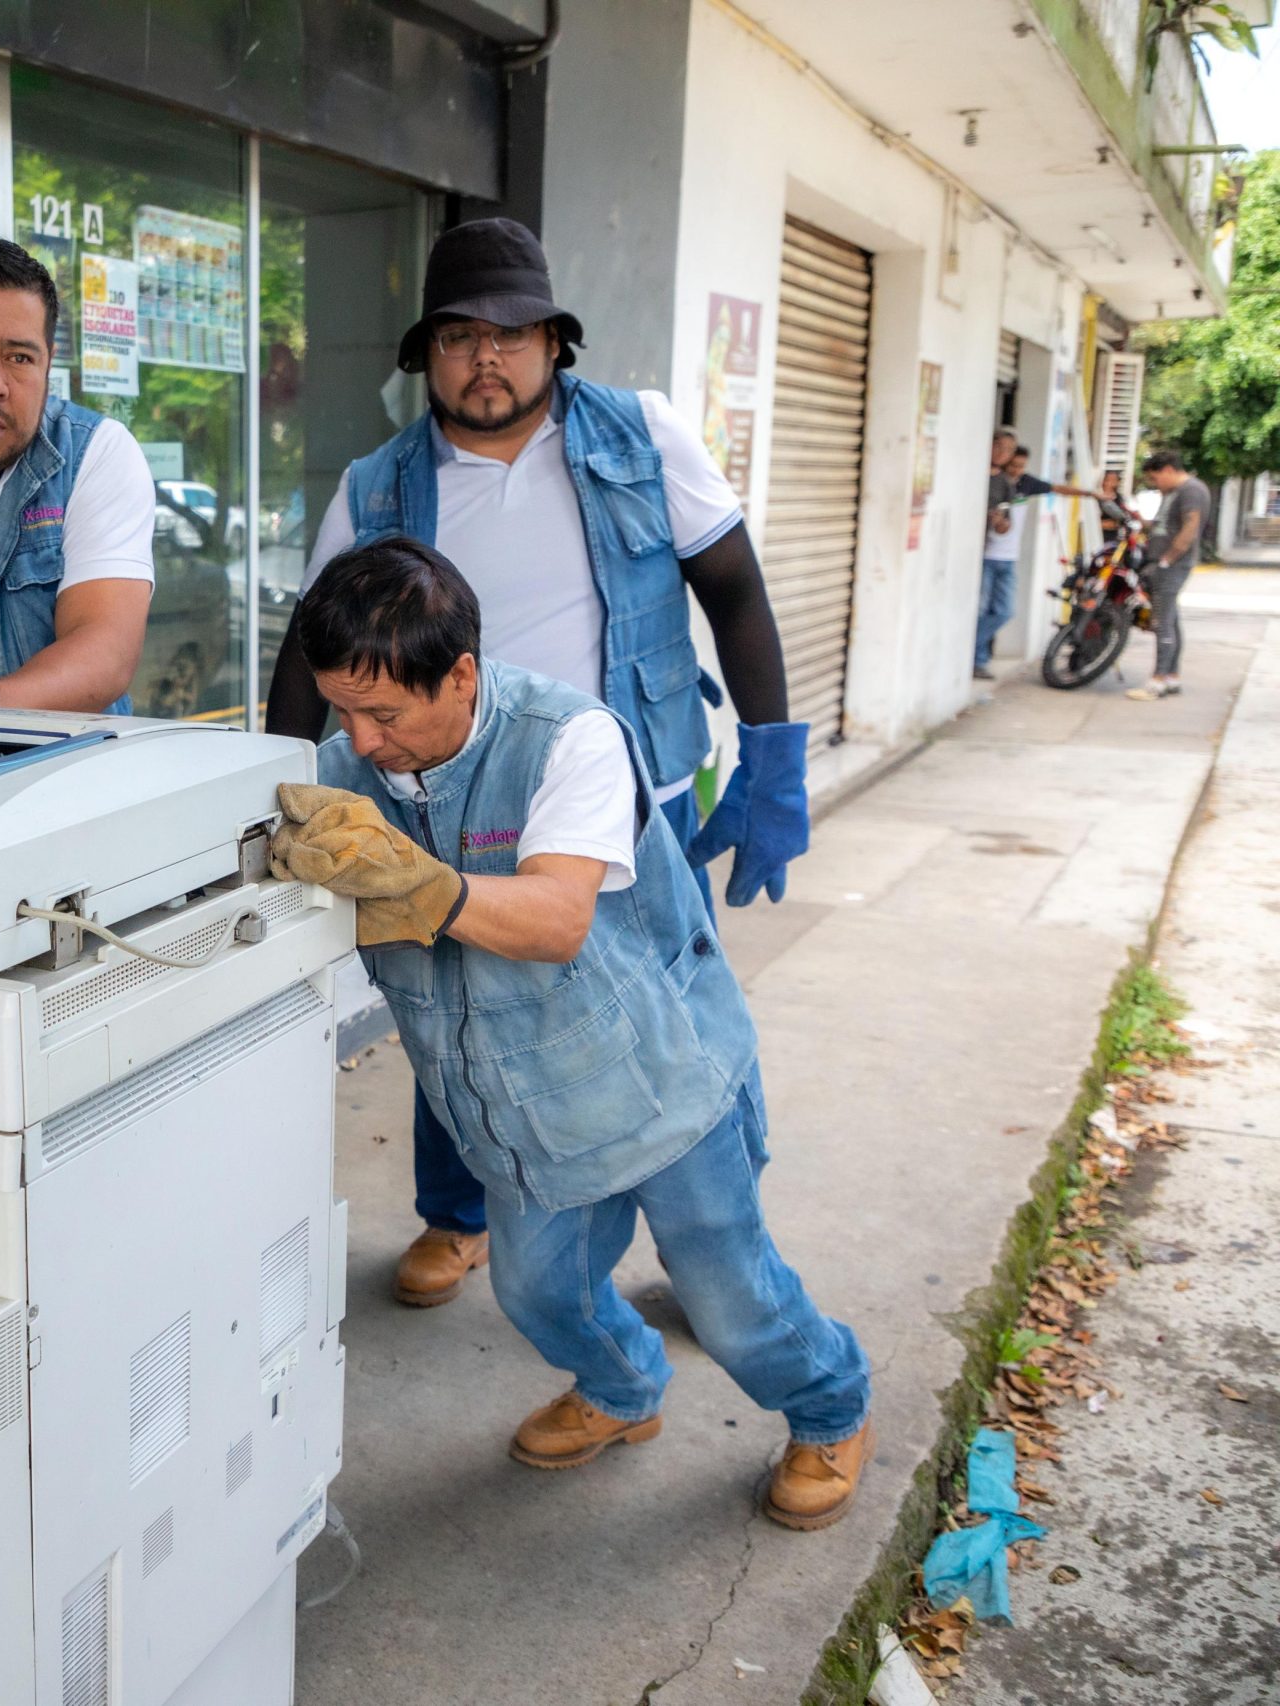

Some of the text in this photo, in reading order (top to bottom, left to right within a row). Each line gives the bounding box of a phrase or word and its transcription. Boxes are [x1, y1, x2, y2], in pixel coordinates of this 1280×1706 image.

[30, 193, 72, 239] 121
[87, 209, 101, 240] A
[84, 319, 137, 338] ESCOLARES
